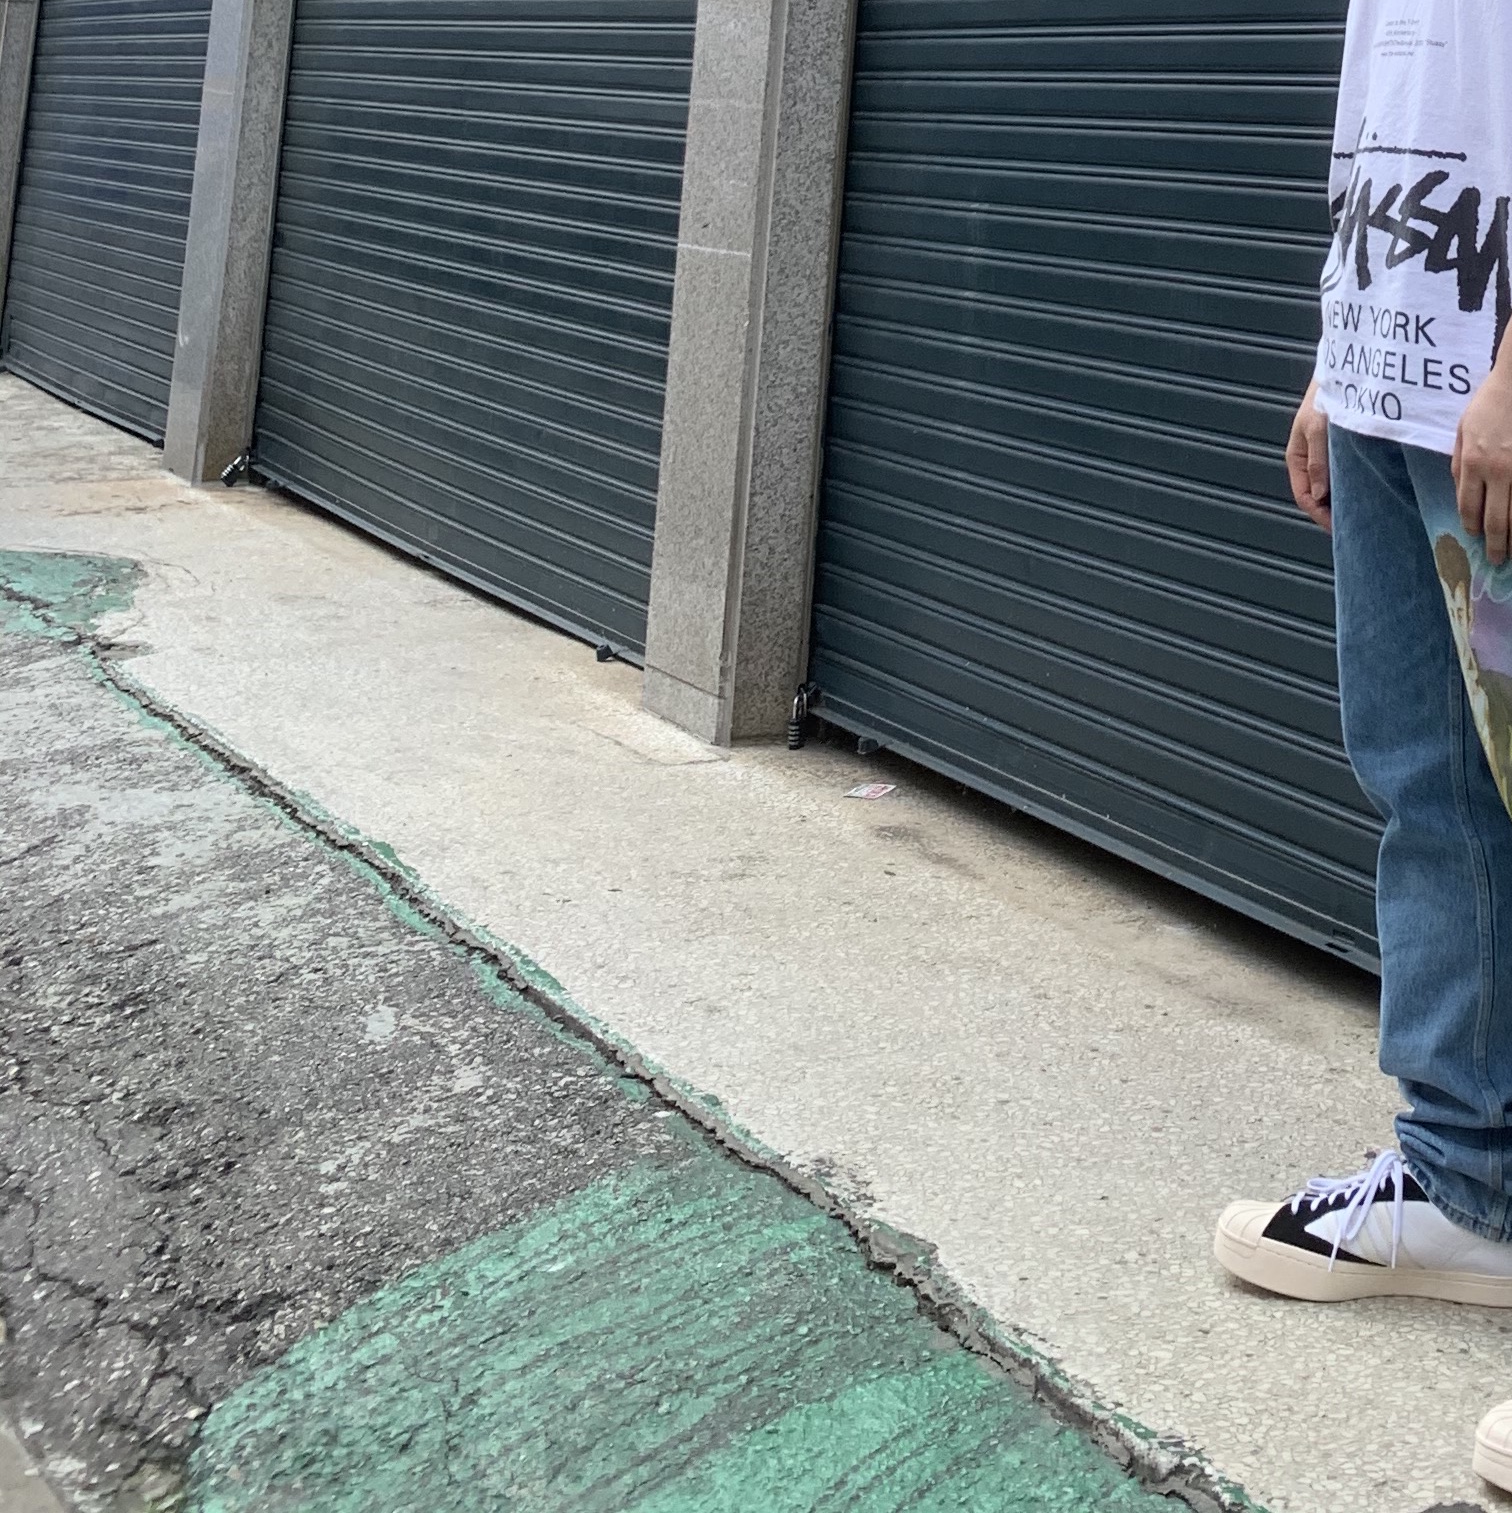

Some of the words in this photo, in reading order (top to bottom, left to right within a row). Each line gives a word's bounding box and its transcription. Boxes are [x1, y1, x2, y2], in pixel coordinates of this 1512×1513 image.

[1327, 299, 1362, 333] NEW
[1369, 305, 1437, 348] YORK
[1341, 343, 1471, 395] ANGELES
